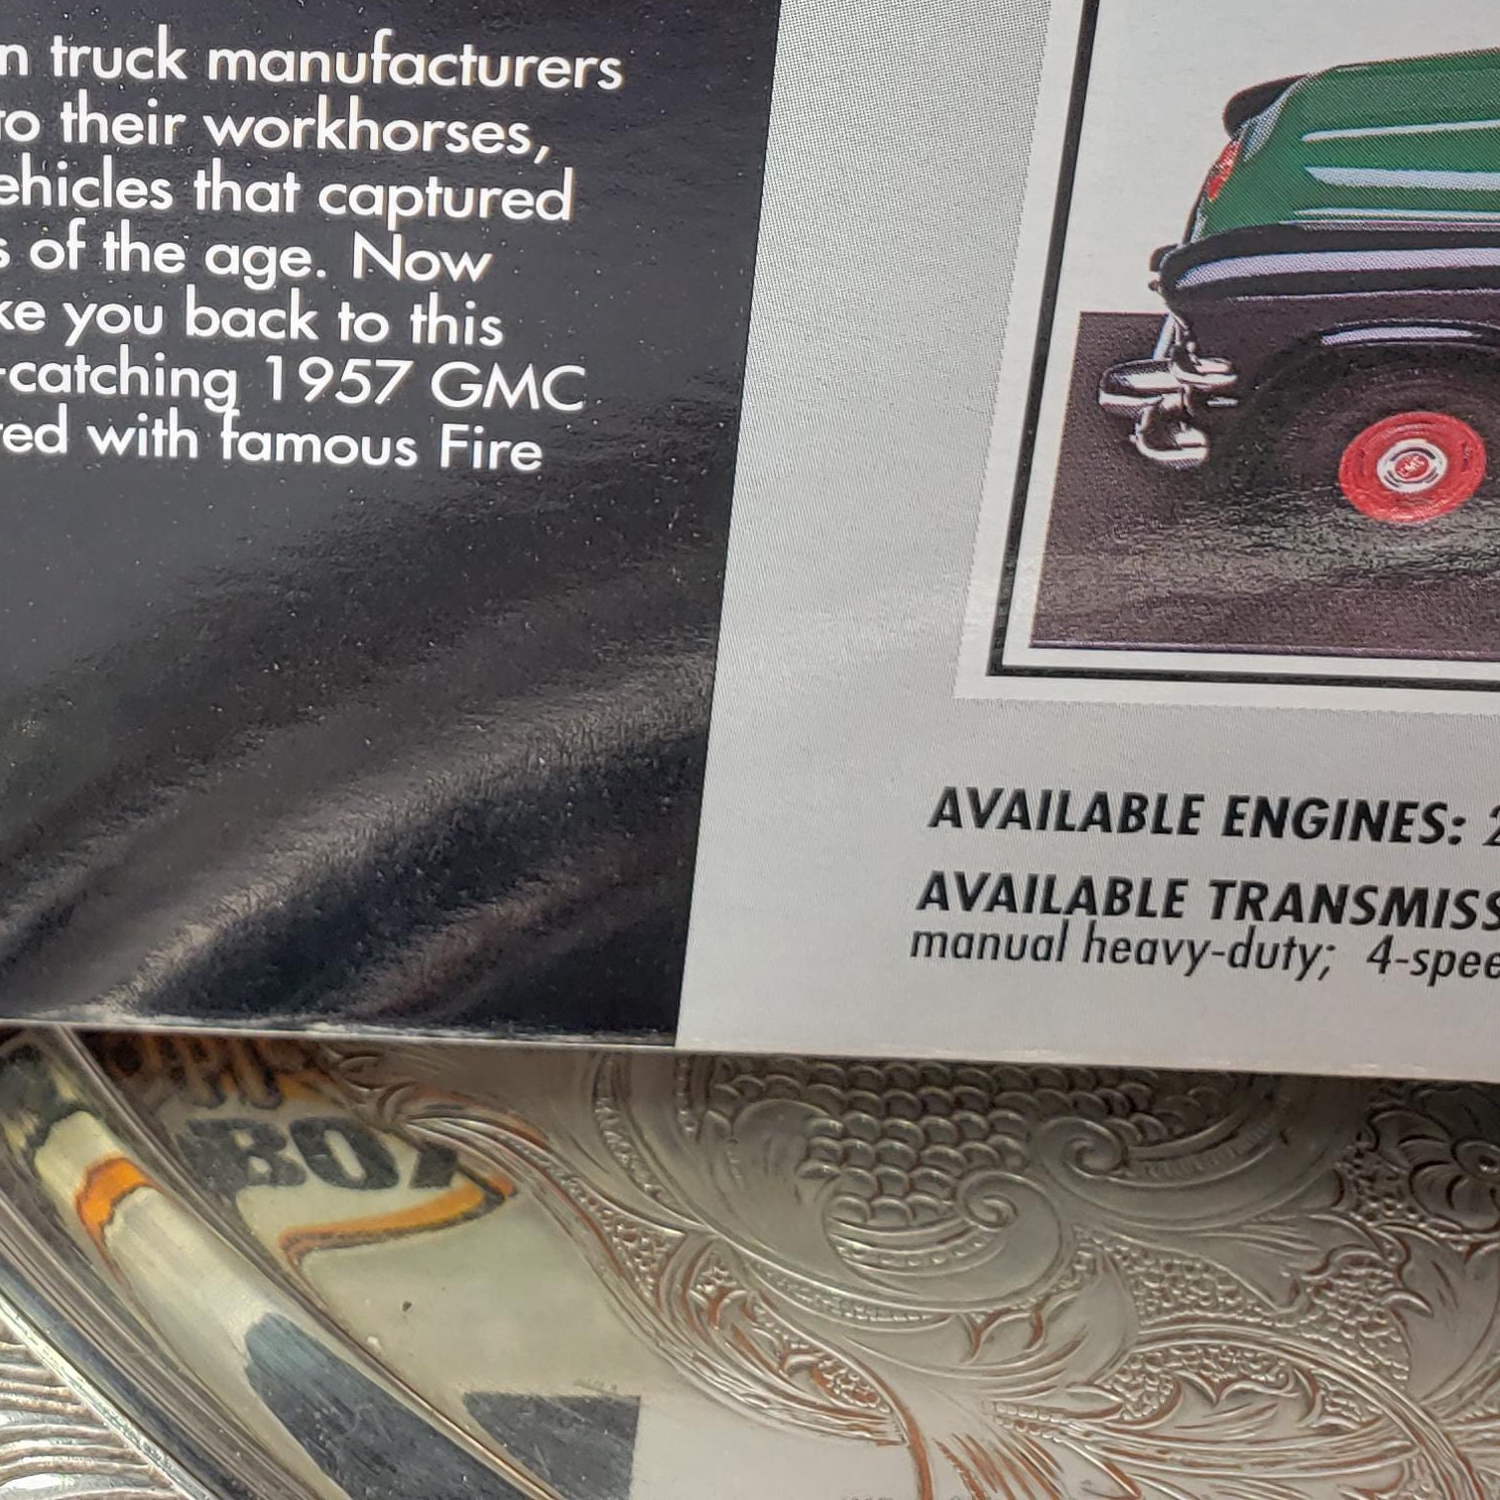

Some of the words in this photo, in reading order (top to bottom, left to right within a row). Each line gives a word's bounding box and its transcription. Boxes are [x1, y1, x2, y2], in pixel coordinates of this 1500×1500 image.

[49, 22, 189, 81] truck
[206, 26, 624, 91] manufacturers
[58, 87, 188, 147] their
[201, 93, 552, 165] workhorses,
[192, 156, 302, 214] that
[317, 165, 574, 233] captured
[28, 216, 87, 271] of
[101, 217, 187, 275] the
[203, 242, 329, 292] age.
[352, 230, 494, 283] Now
[61, 301, 164, 348] you
[184, 282, 320, 342] back
[336, 300, 391, 344] to
[408, 290, 505, 348] this
[264, 354, 415, 406] 1957
[430, 360, 587, 413] GMC
[85, 405, 199, 460] with
[218, 406, 419, 468] famous
[437, 421, 544, 472] Fire
[925, 785, 1205, 836] AVAILABLE
[1220, 794, 1467, 846] ENGINES:
[914, 869, 1190, 919] AVAILABLE
[908, 918, 1070, 963] manual
[1081, 918, 1337, 982] heavy-duty;
